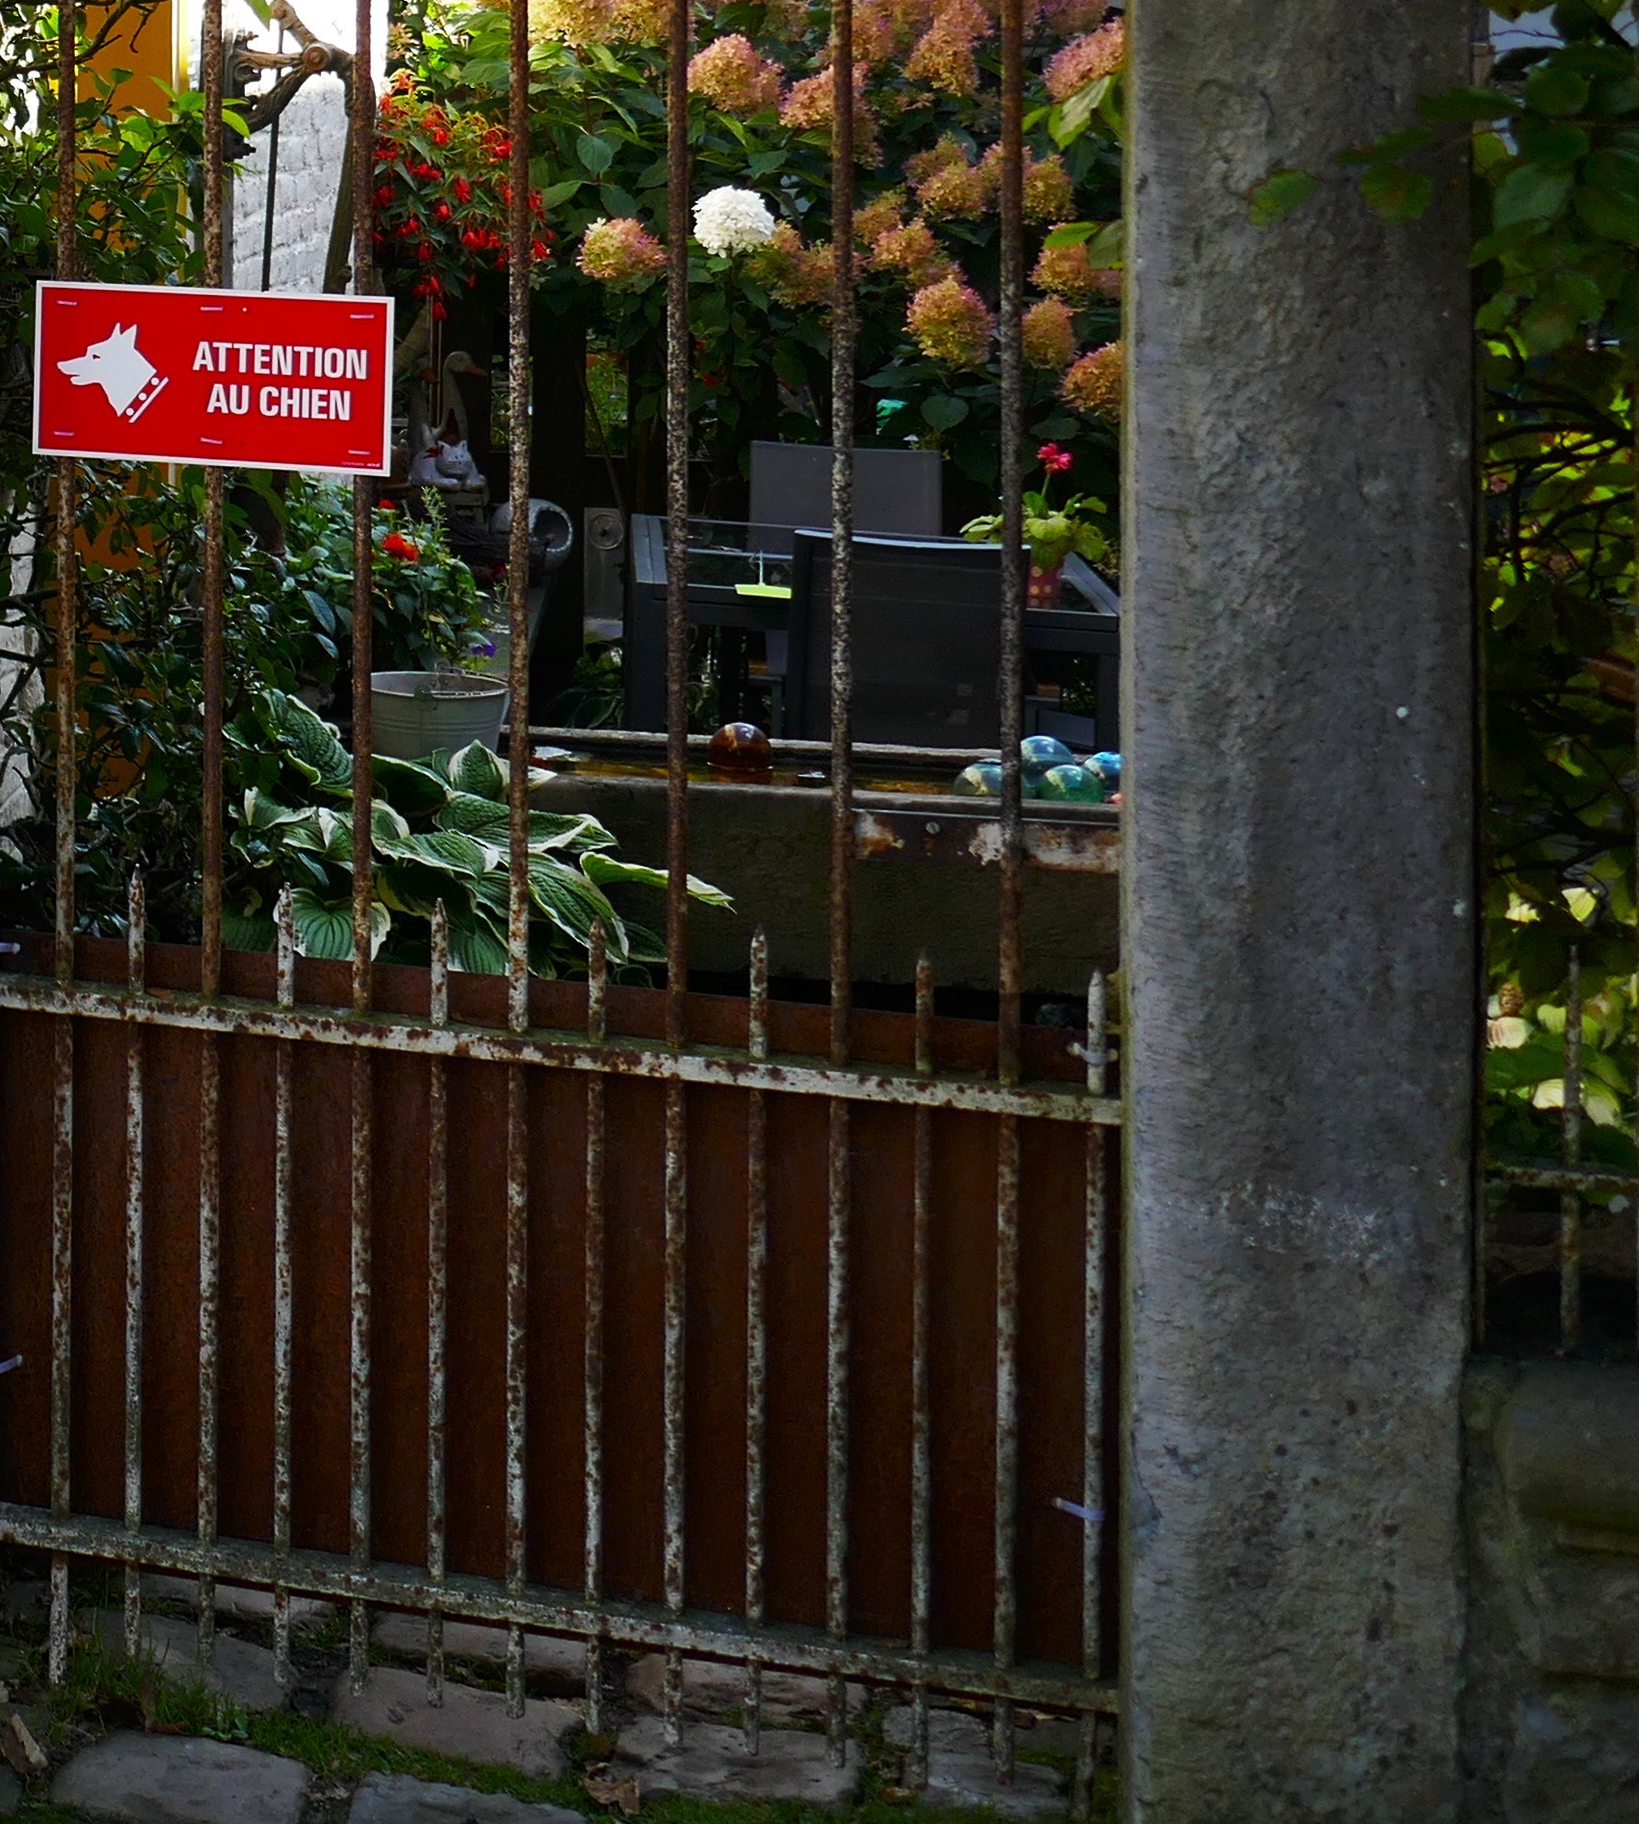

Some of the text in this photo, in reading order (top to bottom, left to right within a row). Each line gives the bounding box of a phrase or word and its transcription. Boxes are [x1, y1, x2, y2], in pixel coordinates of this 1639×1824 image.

[193, 341, 368, 380] ATTENTION
[206, 383, 351, 420] AU CHIEN
